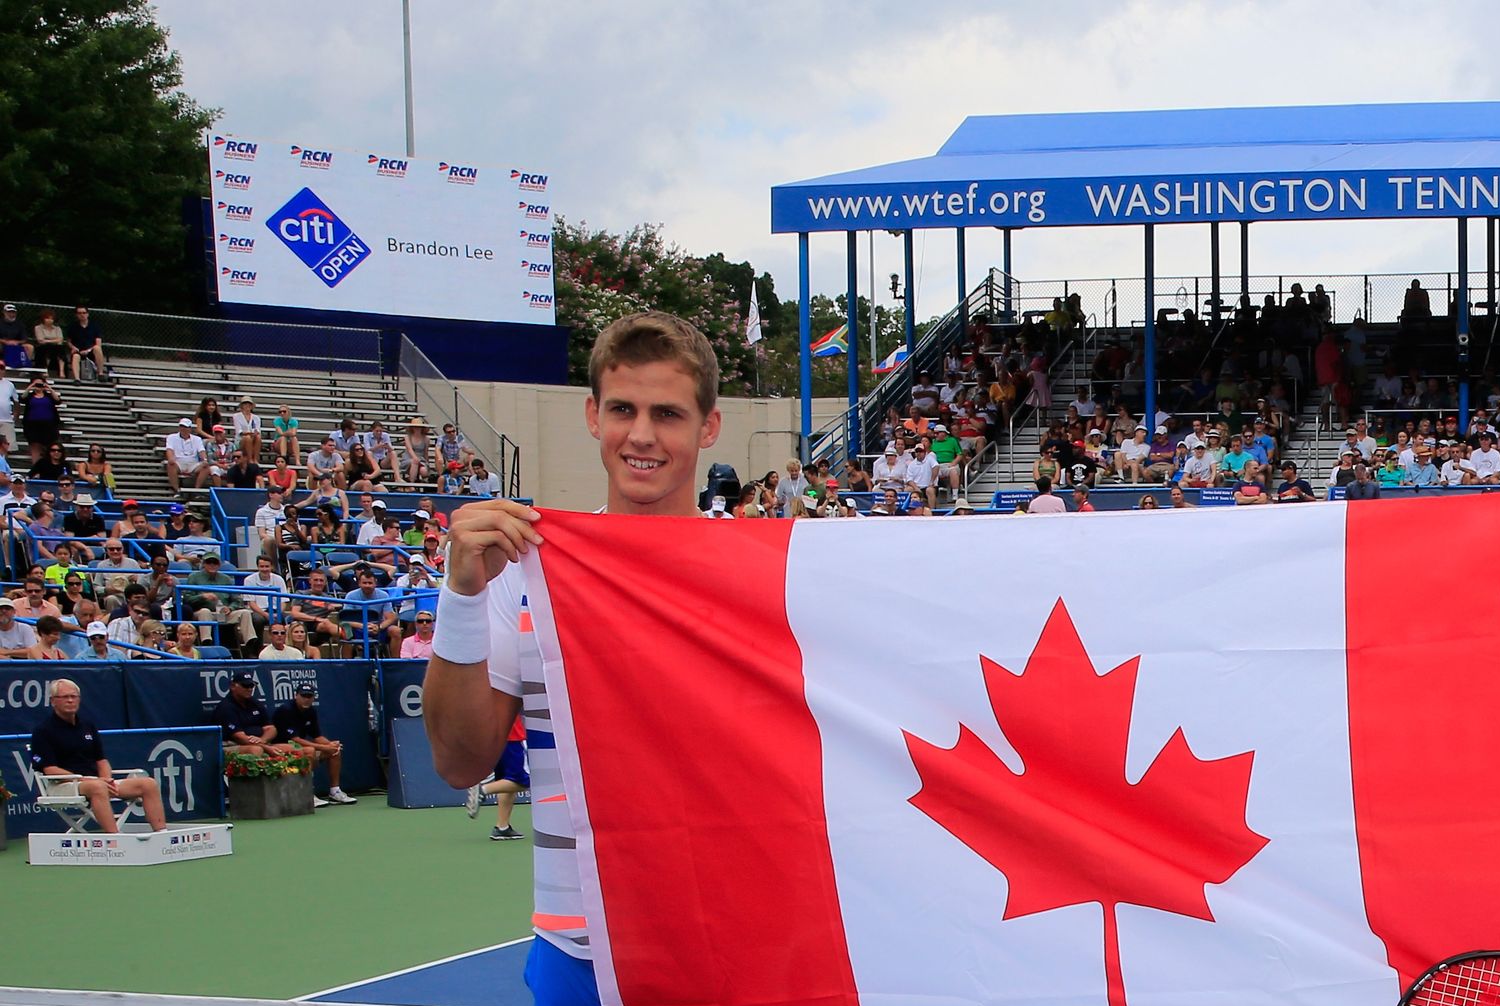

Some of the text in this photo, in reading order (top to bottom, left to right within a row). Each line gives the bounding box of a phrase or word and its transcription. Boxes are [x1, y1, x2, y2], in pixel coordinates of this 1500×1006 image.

[225, 140, 258, 154] RCN
[301, 150, 333, 163] RCN
[377, 158, 408, 171] RCN
[449, 166, 478, 178] RCN
[224, 173, 251, 185] RCN
[520, 173, 548, 185] RCN
[807, 182, 1047, 223] www.wtef.org
[1086, 178, 1368, 218] WASHINGTON
[227, 205, 253, 216] RCN
[526, 204, 549, 214] RCN
[281, 211, 335, 245] citi
[229, 236, 255, 248] RCN
[528, 233, 551, 243] RCN
[387, 237, 494, 260] Brandon Lee
[321, 240, 366, 281] OPEN
[529, 263, 551, 272] RCN
[231, 270, 257, 281] RCN
[530, 294, 553, 303] RCN
[49, 849, 69, 858] Grand
